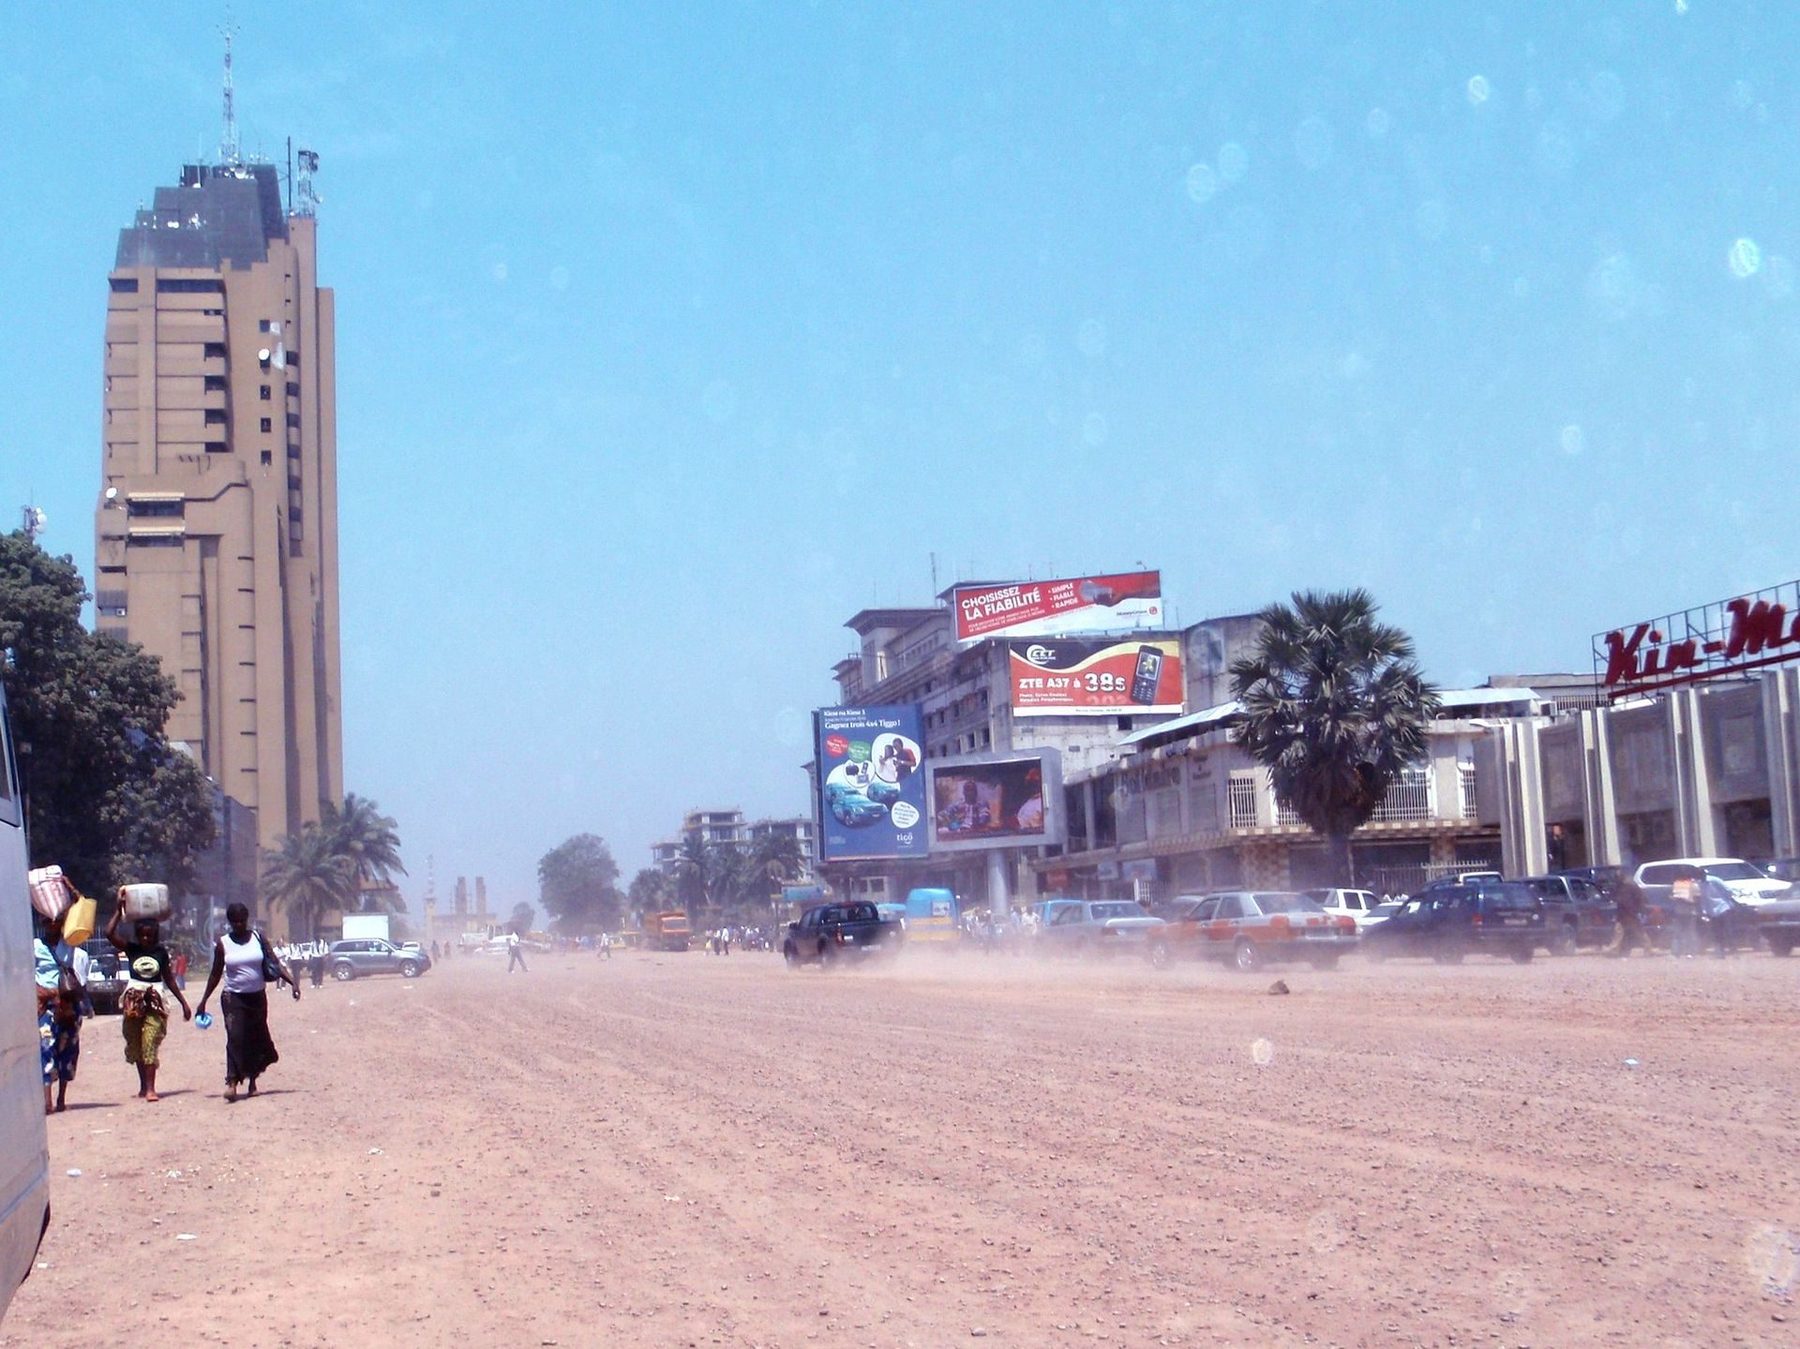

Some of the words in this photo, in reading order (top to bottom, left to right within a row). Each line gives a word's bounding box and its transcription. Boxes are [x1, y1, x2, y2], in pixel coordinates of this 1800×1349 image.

[1052, 583, 1074, 594] SIMPLE
[962, 586, 1020, 609] CHOISISSEZ
[964, 607, 983, 621] LA
[984, 587, 1041, 616] FIABILITÉ
[1019, 678, 1044, 689] ZTE
[1046, 677, 1070, 688] A37
